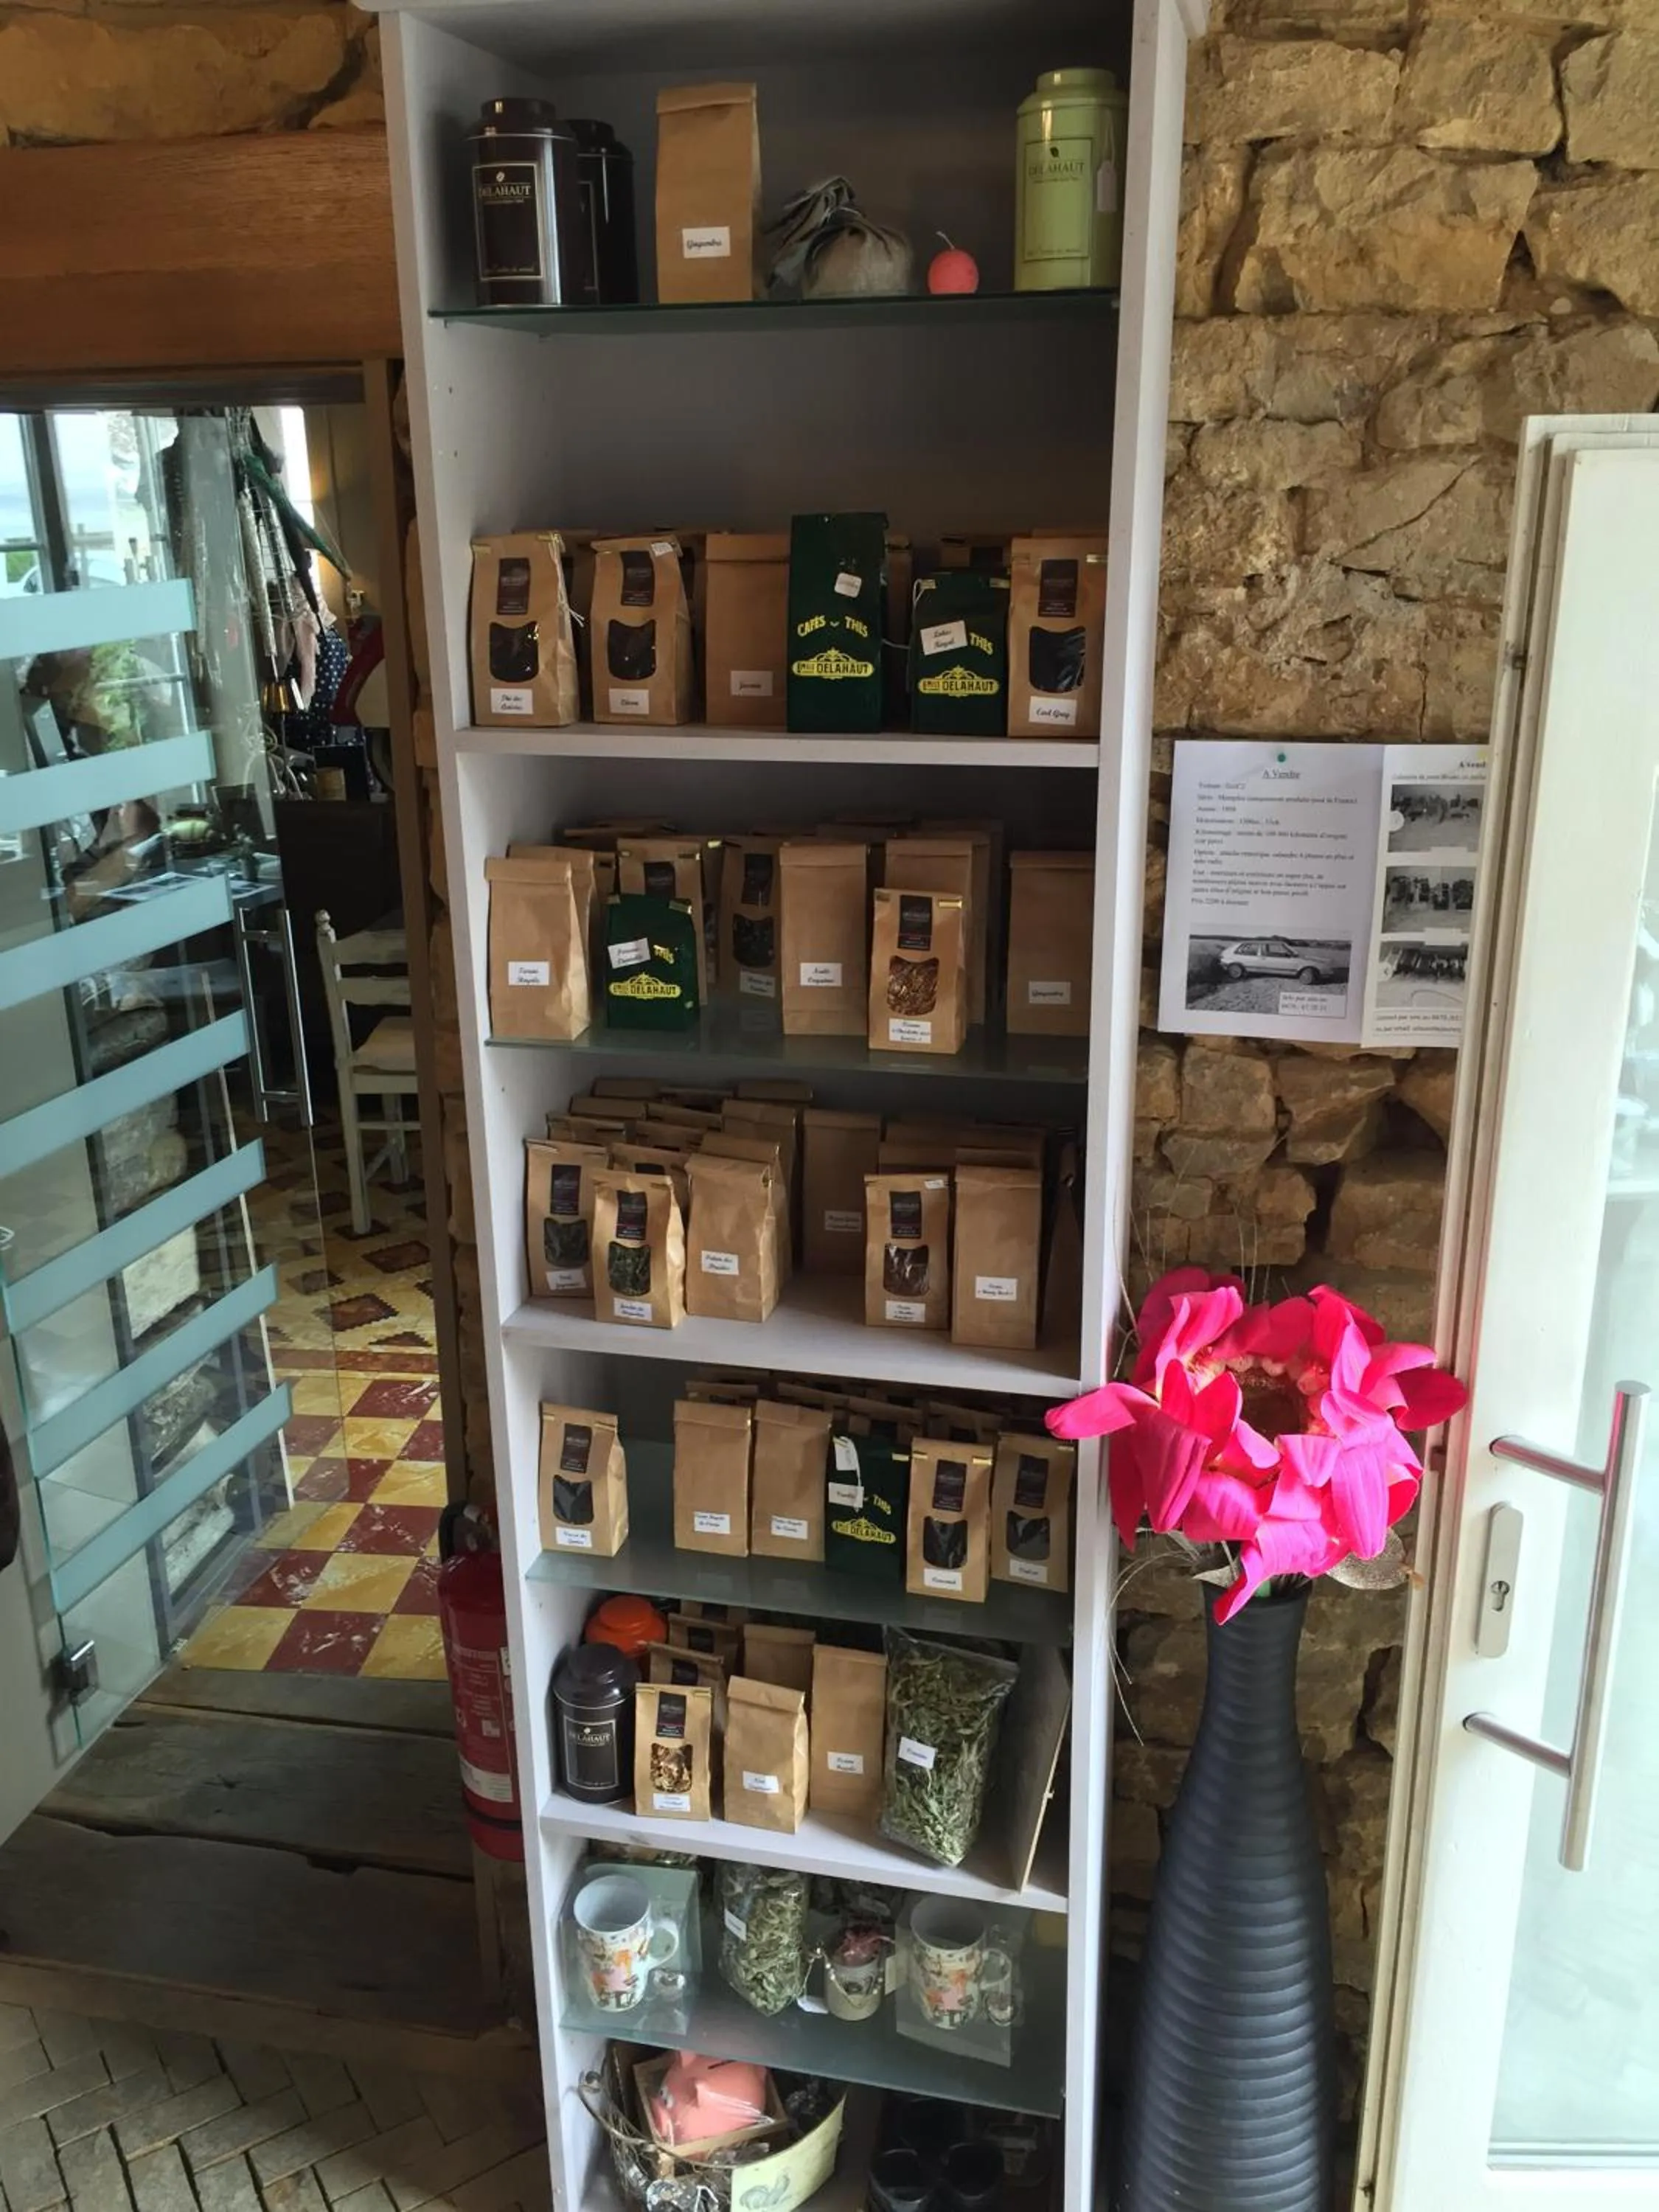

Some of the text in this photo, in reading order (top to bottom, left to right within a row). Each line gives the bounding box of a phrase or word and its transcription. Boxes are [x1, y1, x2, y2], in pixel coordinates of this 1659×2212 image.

[816, 661, 869, 674] DELAHAUT
[942, 680, 995, 691] DELAHAUT
[630, 984, 676, 995] DELAHAUT
